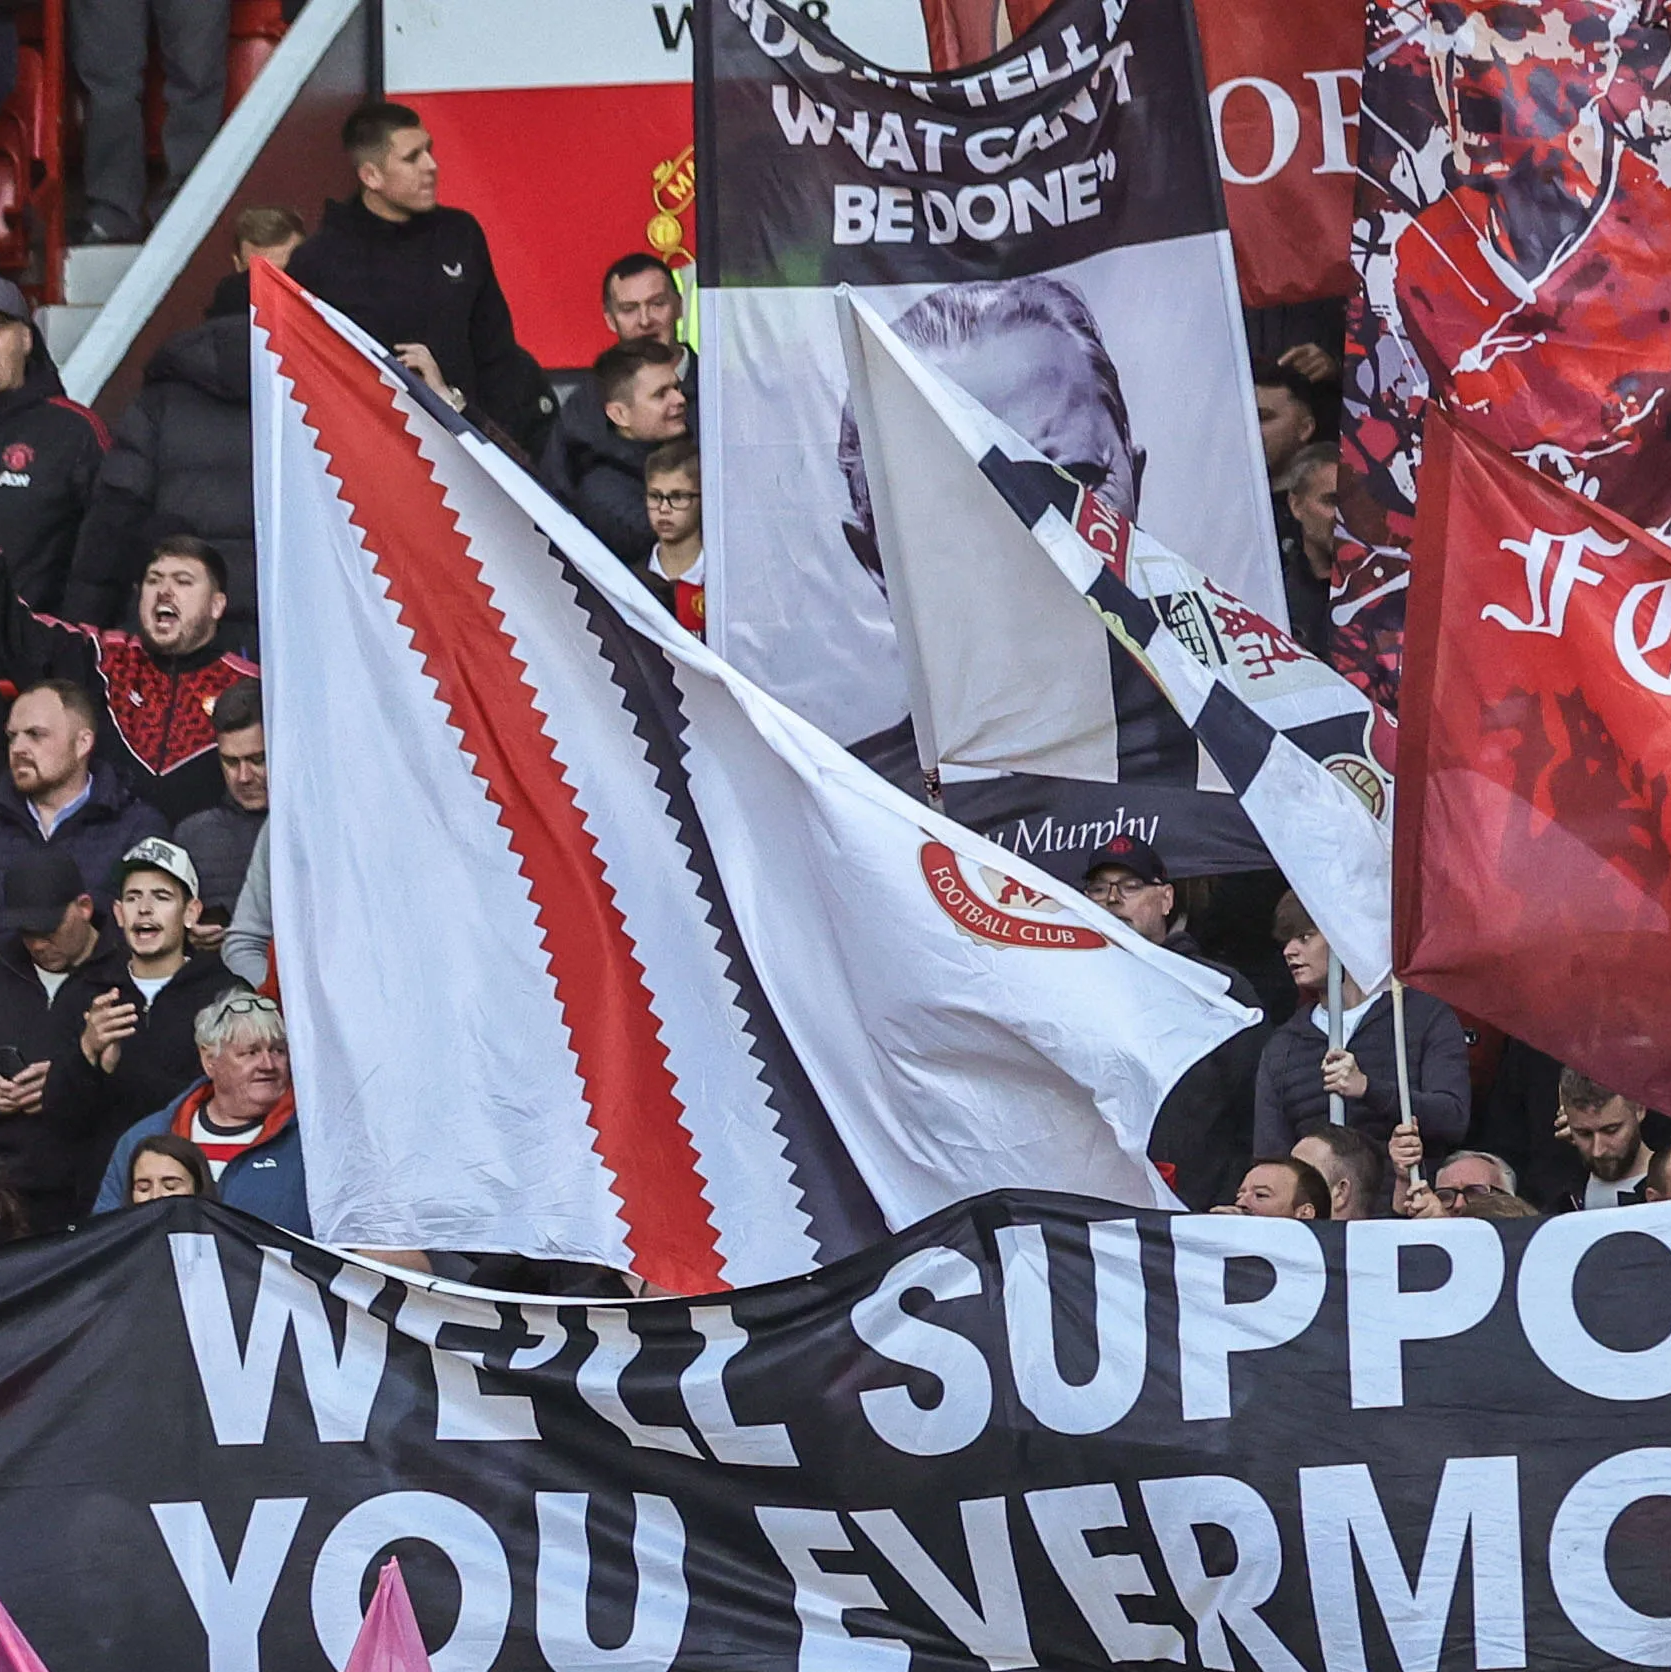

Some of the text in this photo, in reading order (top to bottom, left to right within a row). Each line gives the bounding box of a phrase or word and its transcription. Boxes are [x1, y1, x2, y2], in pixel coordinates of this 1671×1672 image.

[772, 83, 951, 173] WHAT
[833, 184, 914, 245] BE
[1013, 807, 1155, 859] Murphy
[930, 863, 1078, 945] FOOTBALL CLUB
